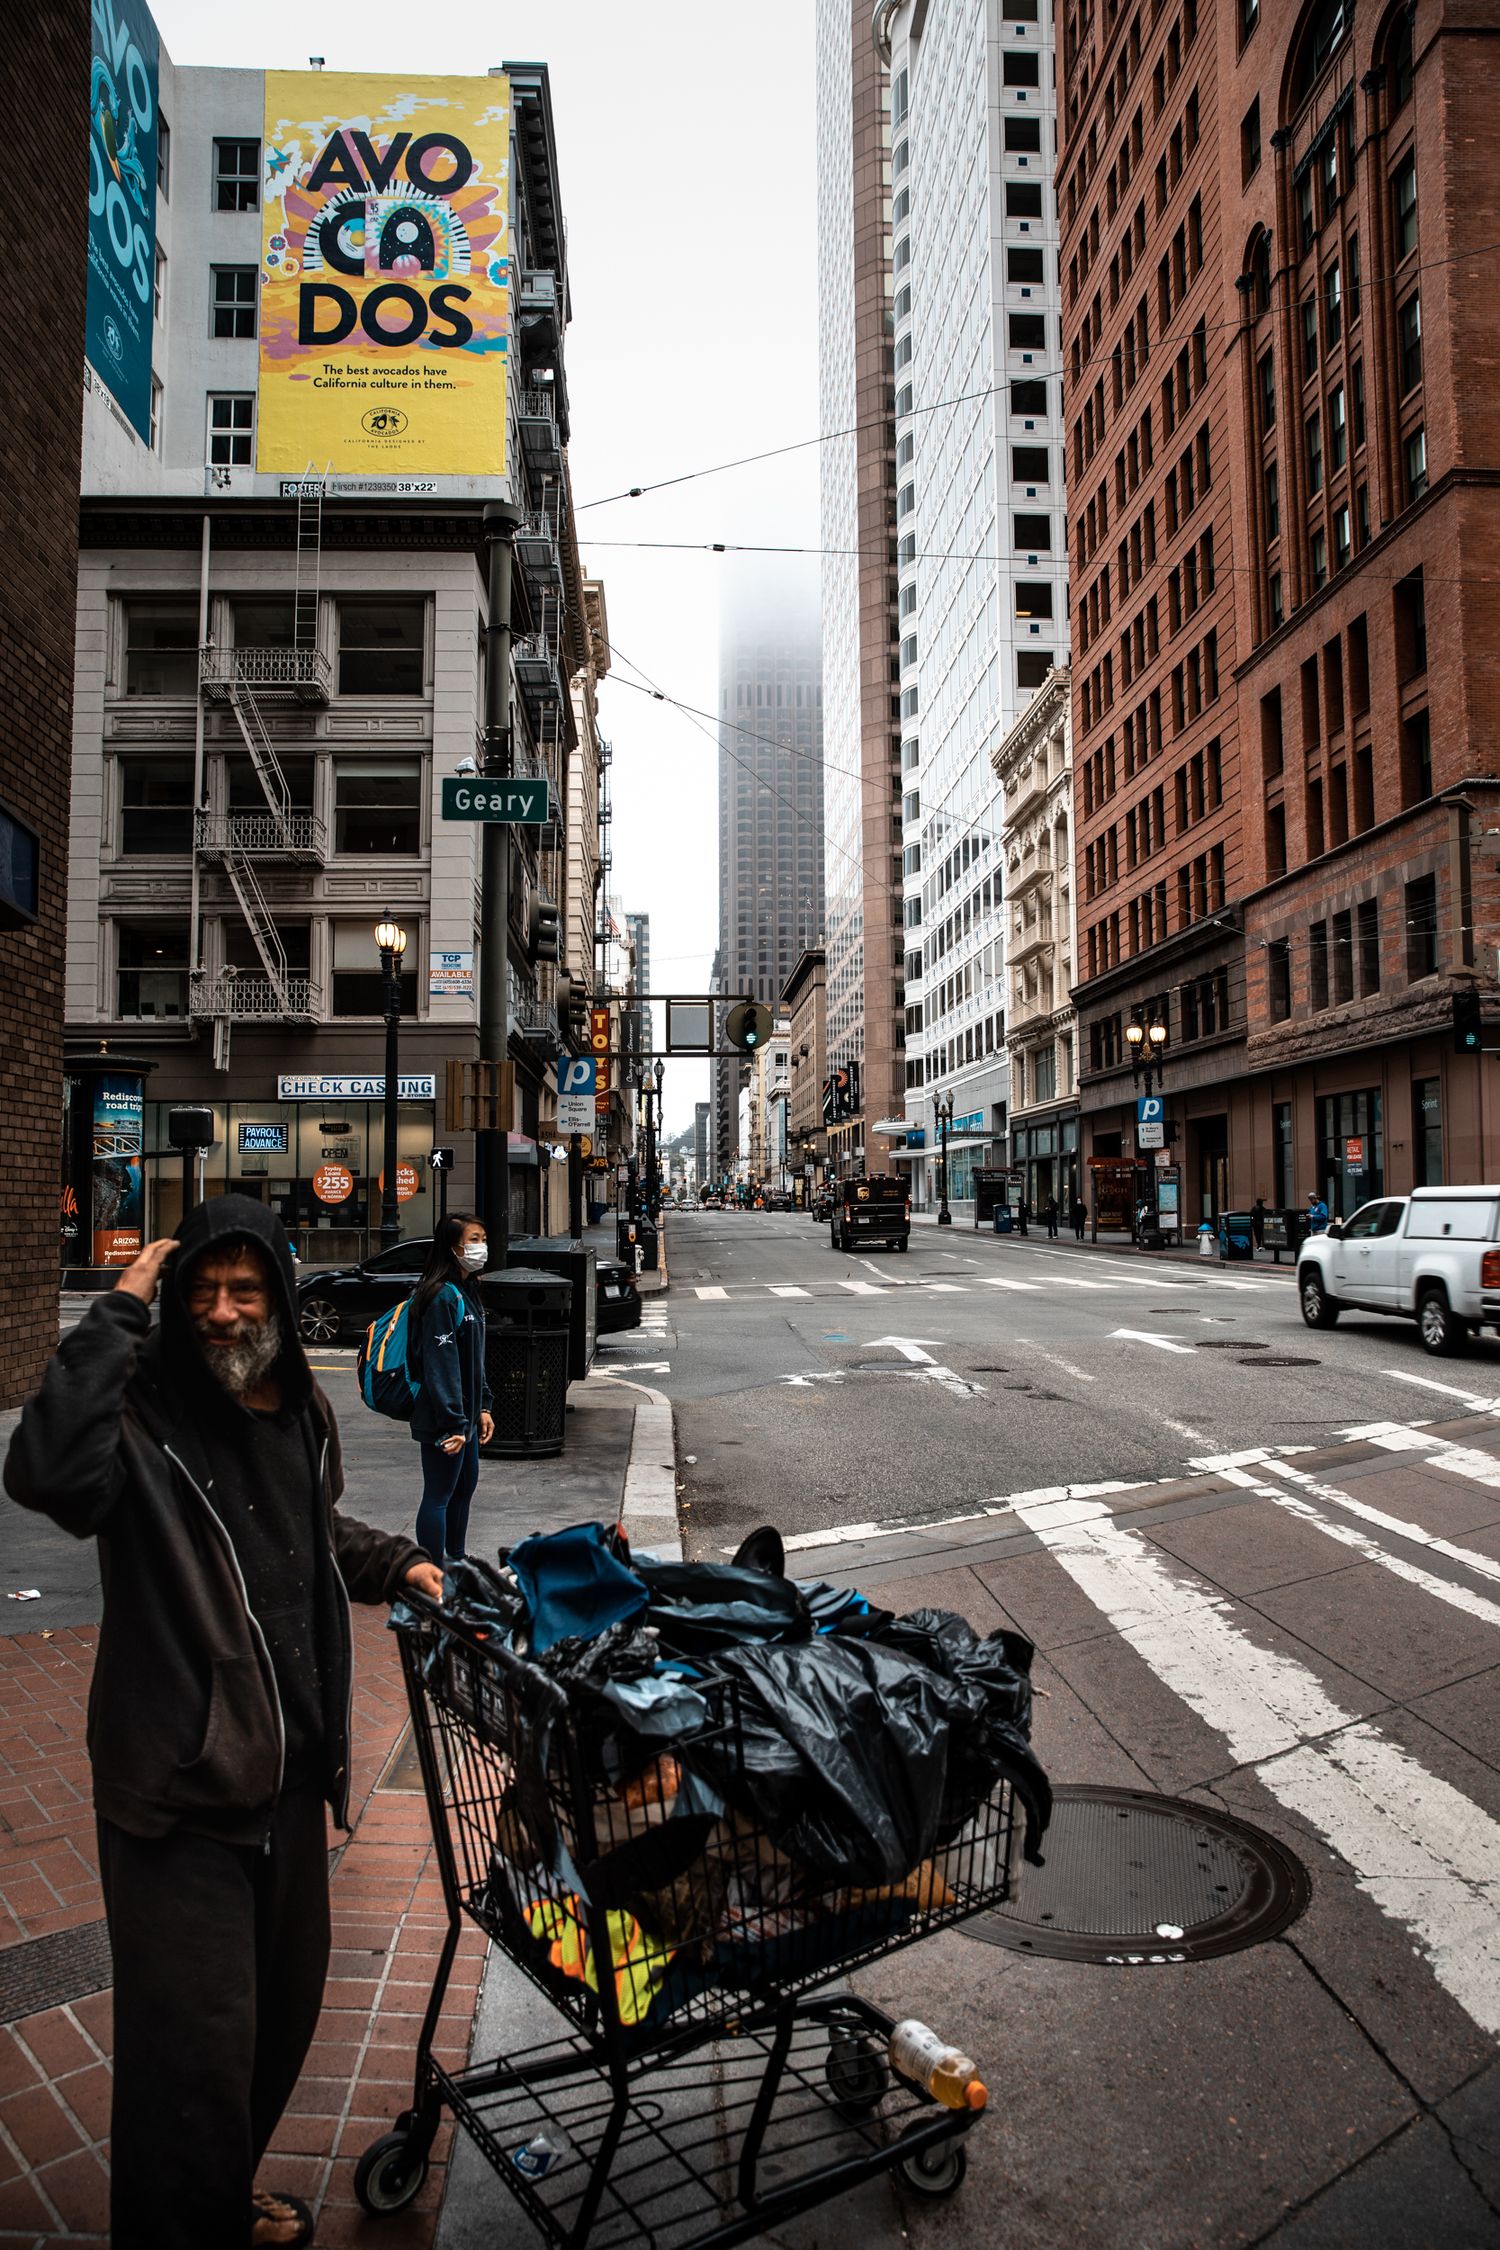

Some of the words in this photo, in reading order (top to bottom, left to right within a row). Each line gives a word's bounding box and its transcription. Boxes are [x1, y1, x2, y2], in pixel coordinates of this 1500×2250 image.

[306, 130, 472, 195] AVO
[298, 283, 473, 347] DOS
[323, 364, 343, 375] The
[346, 364, 369, 375] best
[372, 365, 420, 376] avocados
[423, 366, 447, 376] have
[313, 377, 367, 388] California
[370, 379, 408, 389] culture
[411, 379, 421, 388] in
[424, 379, 456, 389] them.
[370, 409, 400, 417] CALIFORNIA
[283, 483, 320, 492] FOSTER
[455, 788, 534, 817] Geary
[593, 1014, 607, 1089] TOYS
[281, 1081, 343, 1093] CHECK
[351, 1081, 432, 1093] CASING
[106, 1102, 127, 1110] road
[246, 1128, 281, 1137] PAYROLL
[245, 1138, 282, 1148] ADVANCE
[322, 1149, 347, 1157] OPEN
[317, 1176, 350, 1189] $255
